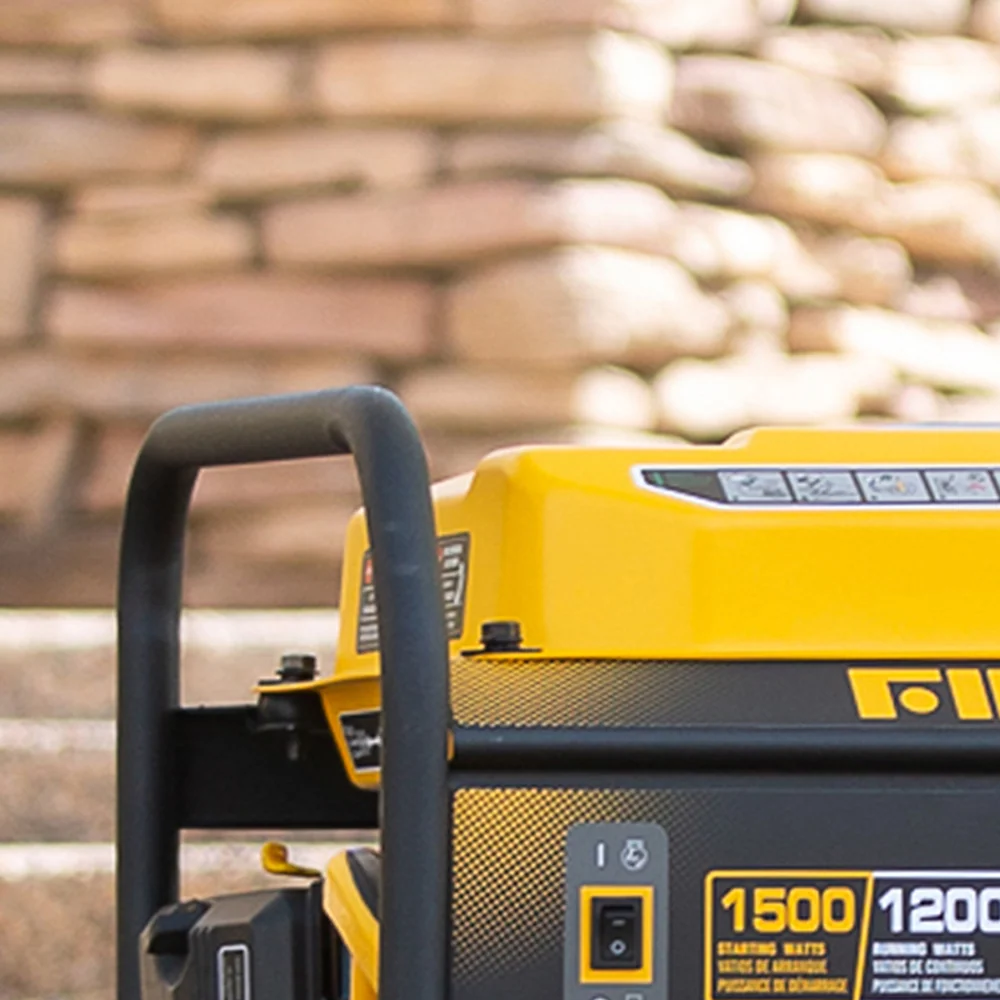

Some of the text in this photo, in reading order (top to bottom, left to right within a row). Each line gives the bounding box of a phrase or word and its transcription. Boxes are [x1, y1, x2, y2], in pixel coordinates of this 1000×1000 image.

[721, 887, 856, 933] 1500
[783, 941, 827, 956] WATTS
[932, 942, 976, 956] WATTS
